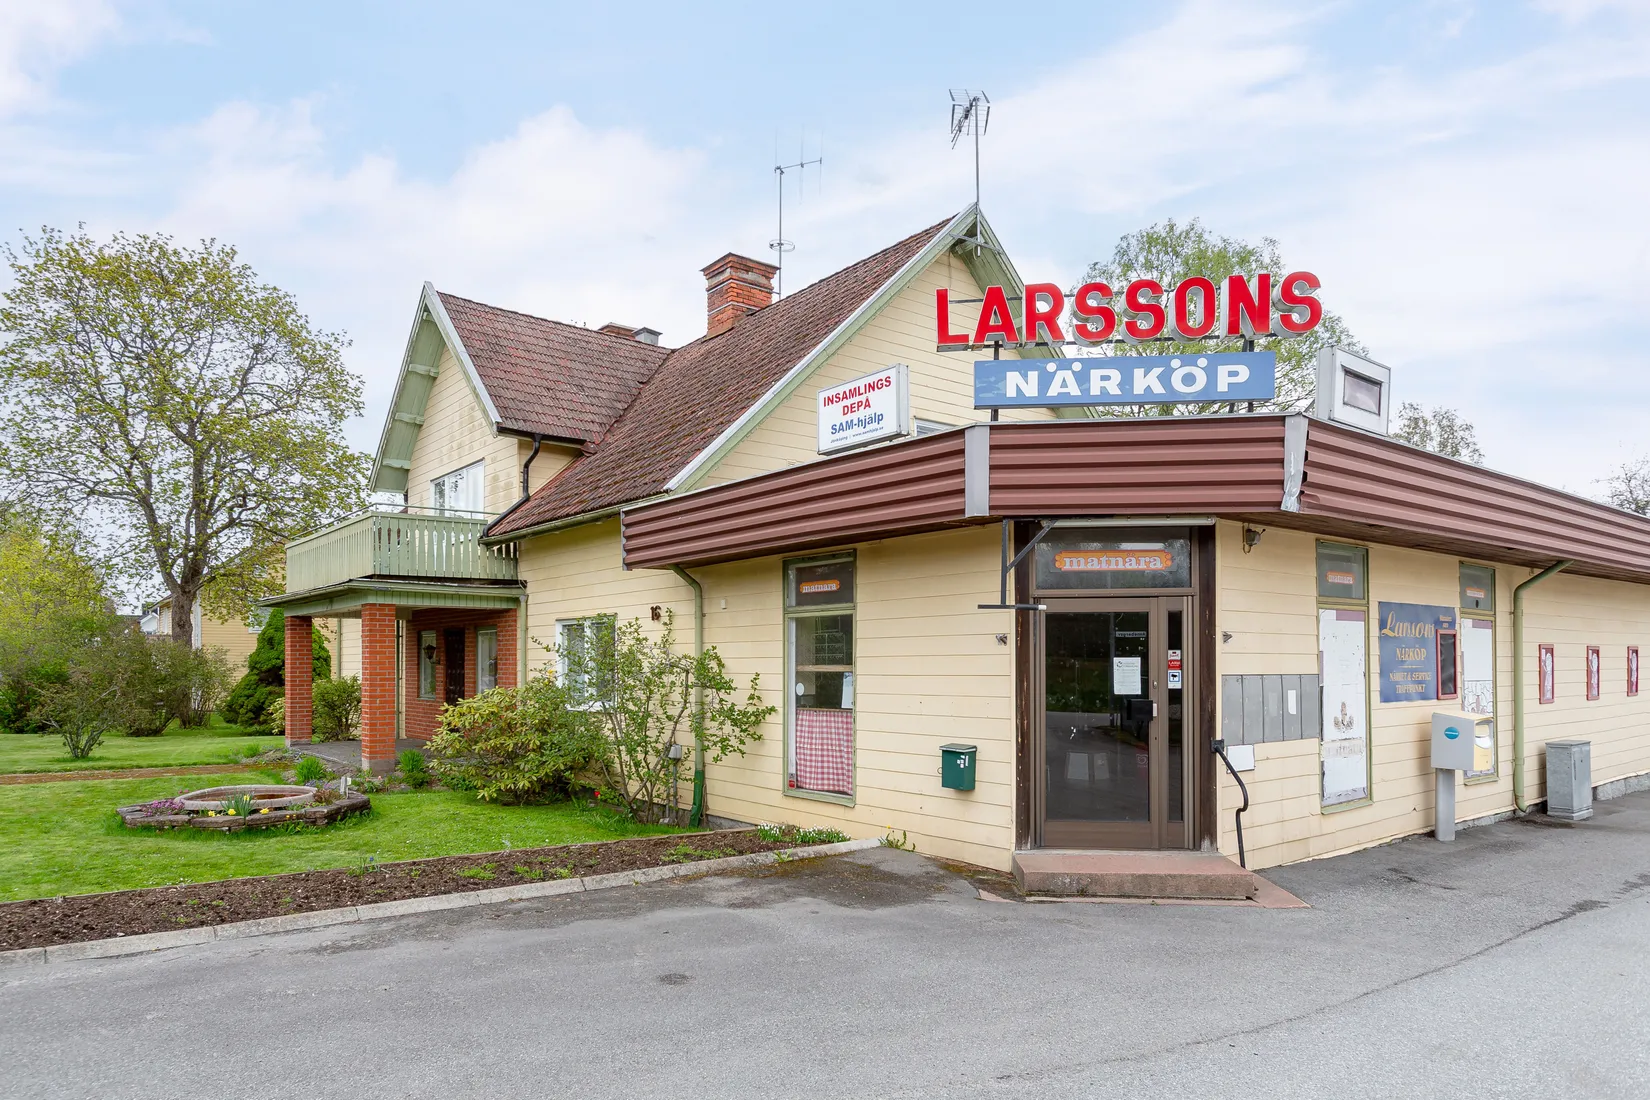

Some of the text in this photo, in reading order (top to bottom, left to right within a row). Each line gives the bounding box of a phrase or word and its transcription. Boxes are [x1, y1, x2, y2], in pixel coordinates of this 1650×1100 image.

[936, 271, 1323, 347] LARSSONS
[1005, 357, 1250, 397] NÄRKÖP
[823, 376, 892, 407] INSAMLINGS
[842, 396, 871, 416] DEPÅ
[831, 412, 884, 435] SAM-hjälp
[1063, 553, 1164, 569] matnära
[650, 605, 662, 621] 16
[1395, 645, 1427, 660] NÄRKÖP
